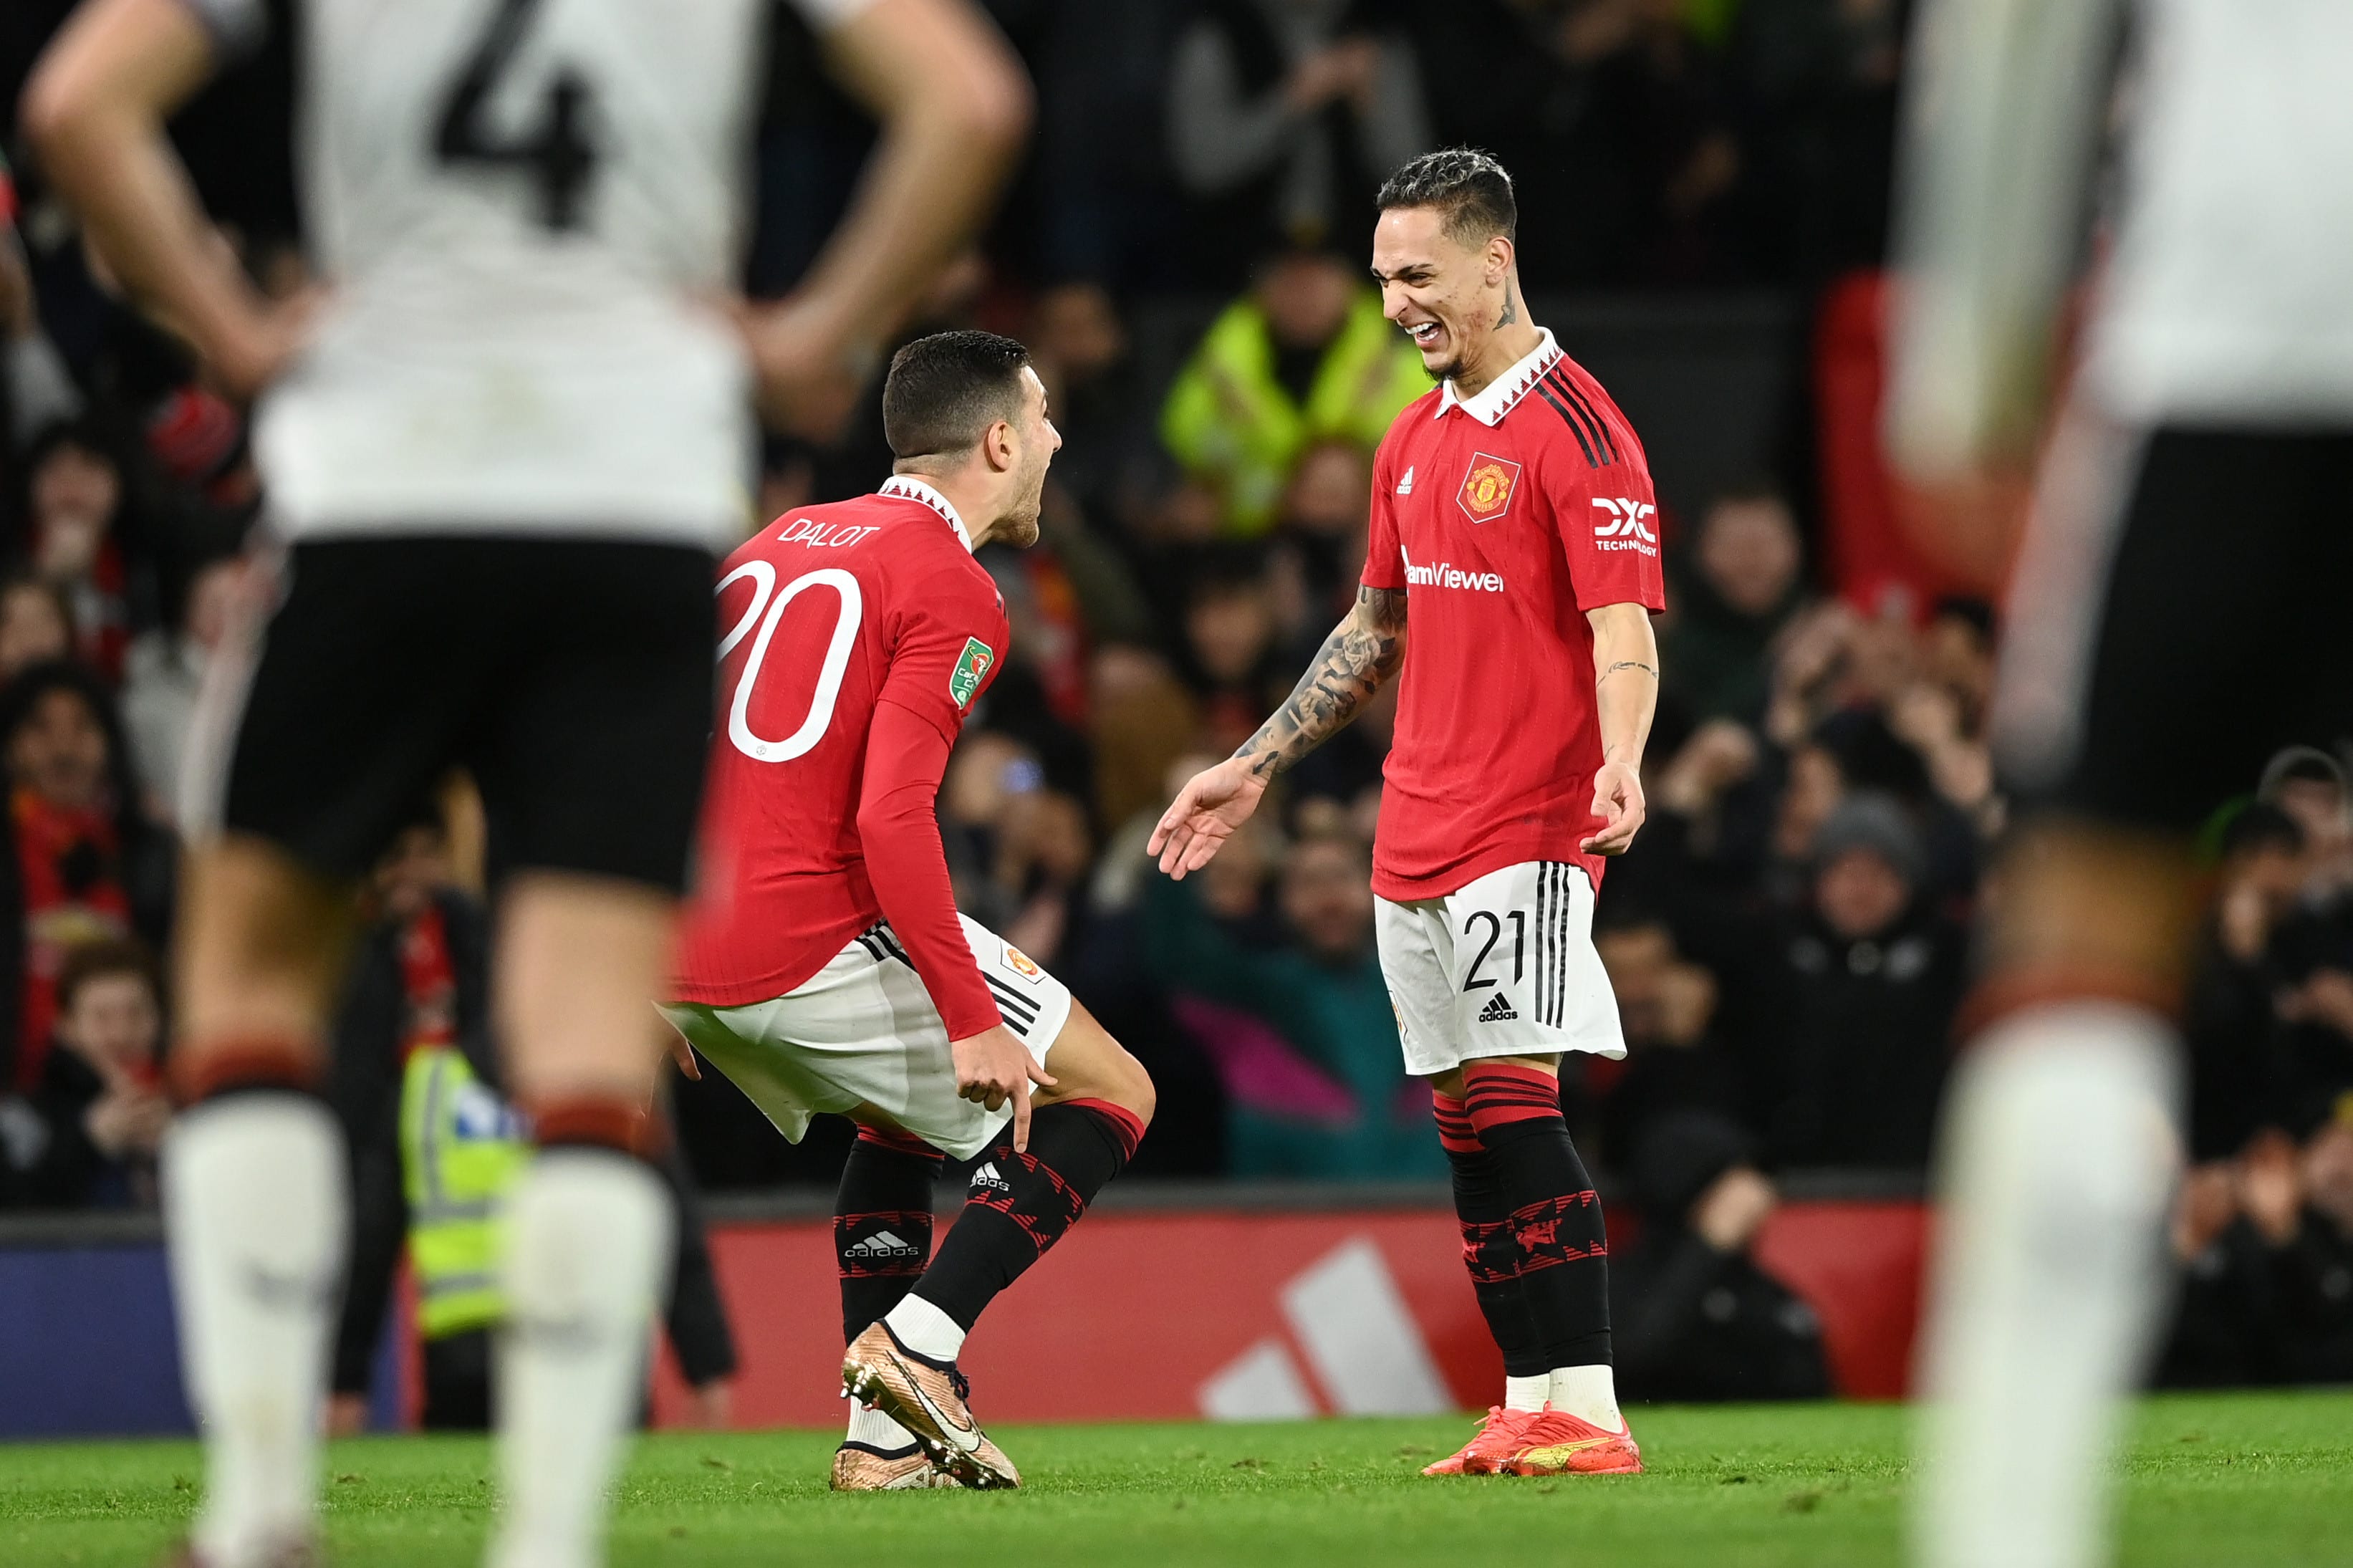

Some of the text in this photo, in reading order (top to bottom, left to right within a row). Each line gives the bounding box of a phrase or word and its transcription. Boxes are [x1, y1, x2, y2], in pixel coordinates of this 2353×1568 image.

[428, 0, 605, 236] 4
[776, 518, 882, 549] DALOT
[1592, 497, 1657, 544] DXC
[1595, 539, 1657, 557] TECHNLOGY
[1463, 910, 1525, 993] 21
[1478, 1010, 1519, 1023] adidas
[844, 1245, 919, 1257] adidas
